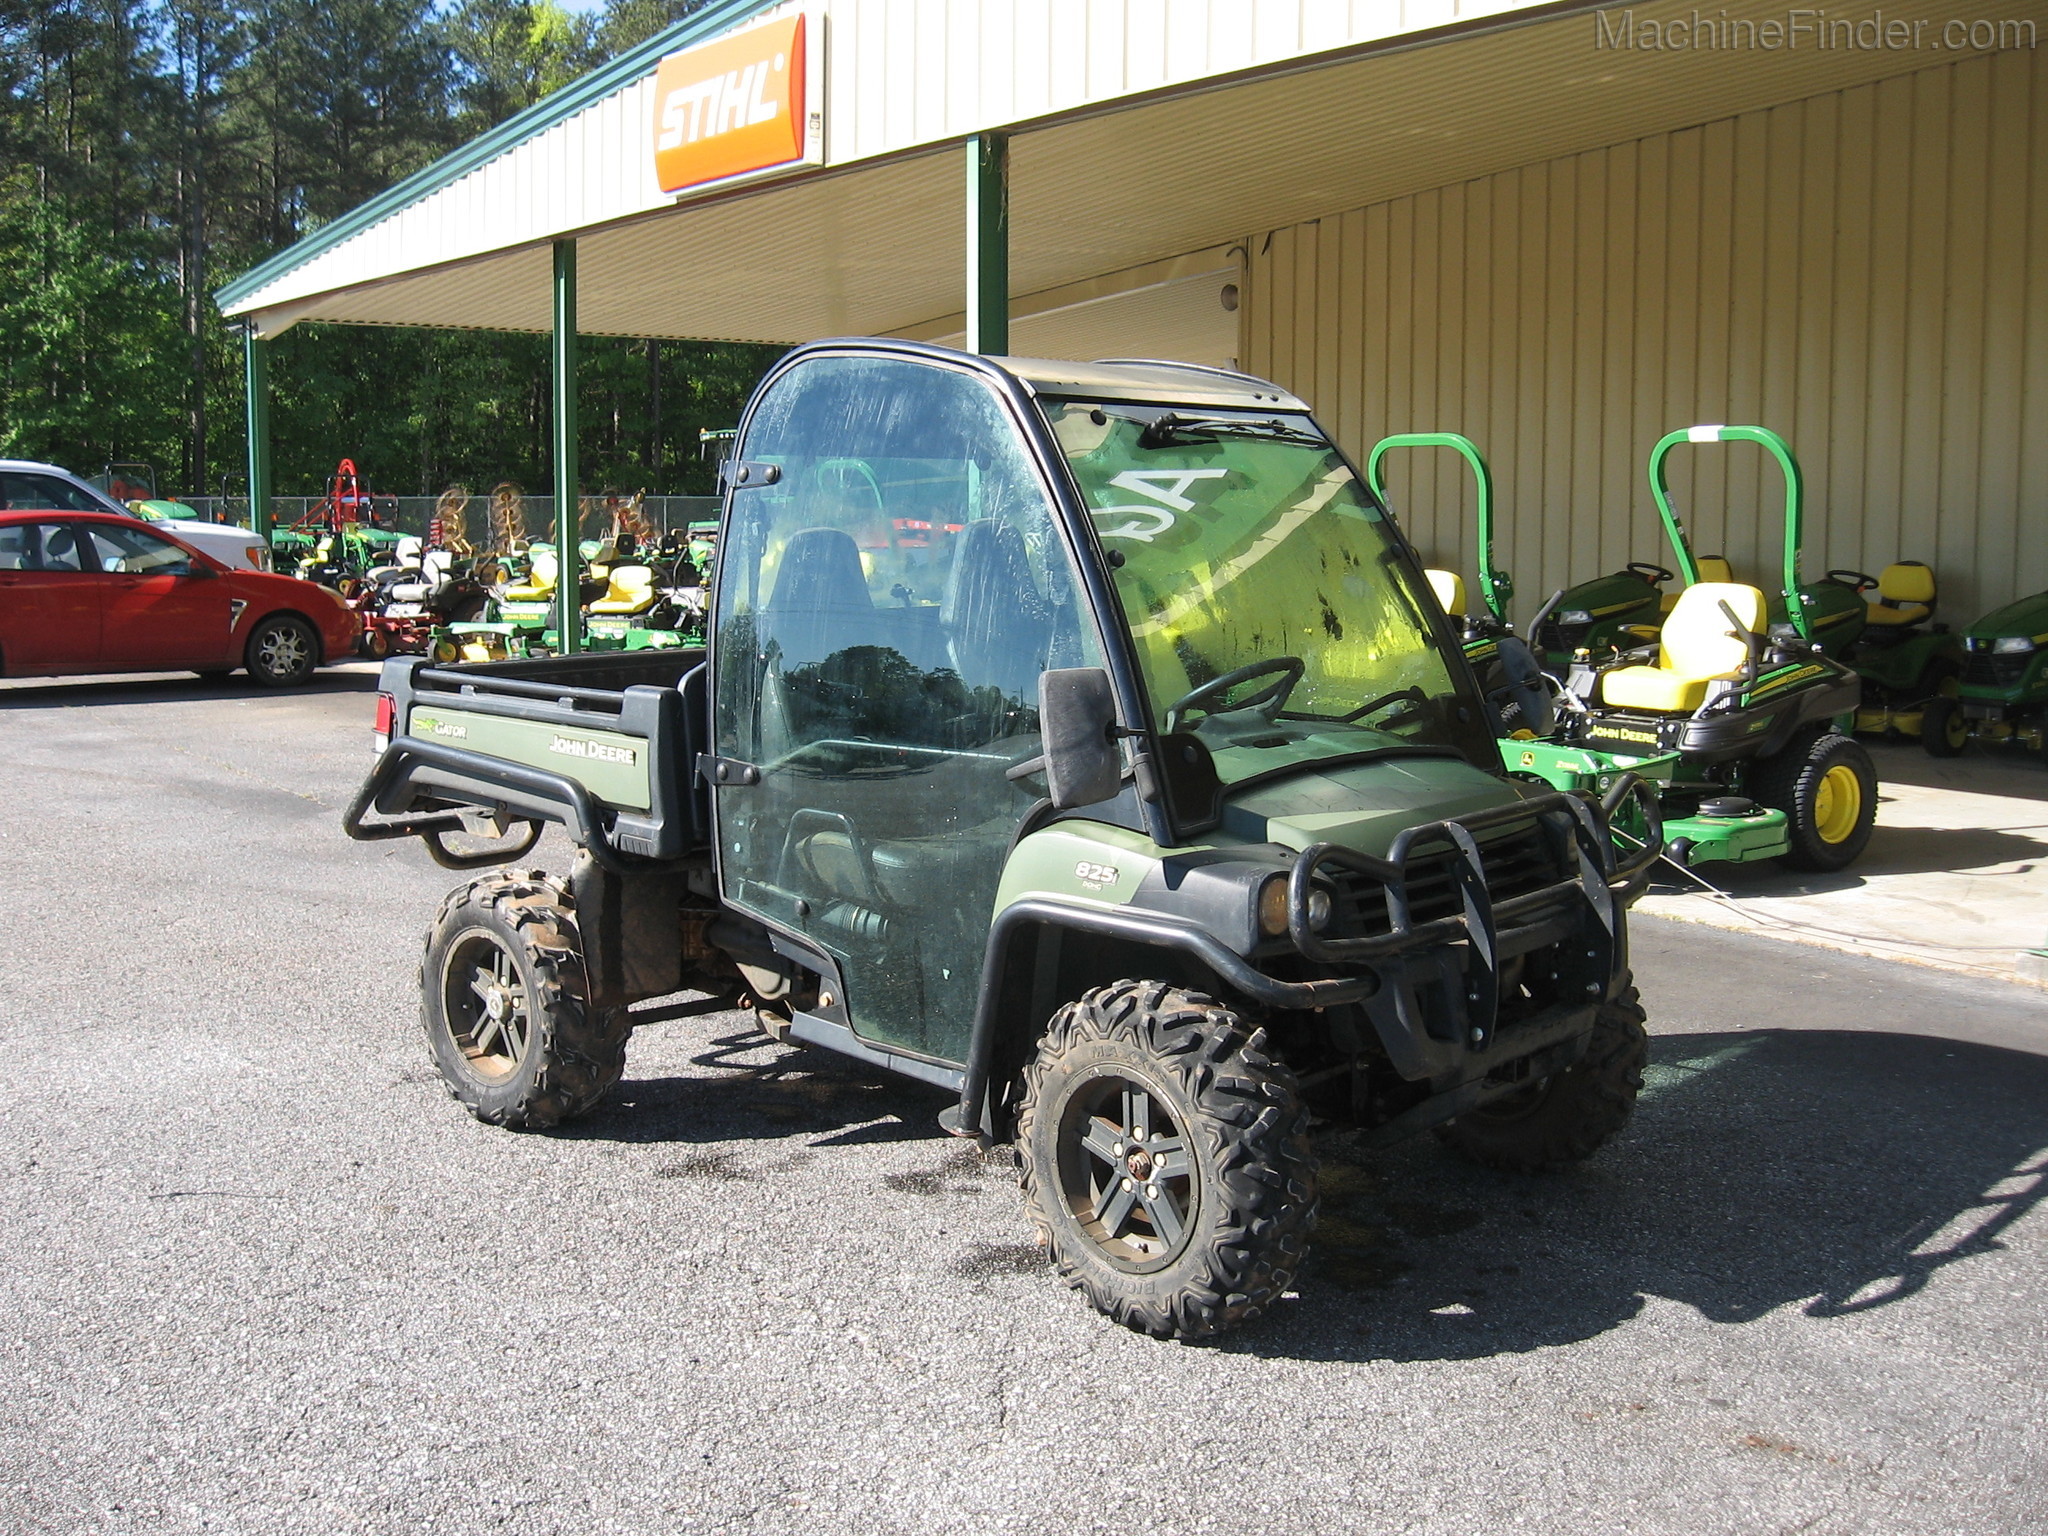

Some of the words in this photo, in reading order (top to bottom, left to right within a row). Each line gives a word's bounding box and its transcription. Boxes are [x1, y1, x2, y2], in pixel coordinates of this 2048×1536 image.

[657, 60, 778, 152] STIHL
[435, 721, 467, 739] GATOR
[1590, 724, 1619, 739] JOHN
[1620, 727, 1658, 744] DEERE
[549, 734, 586, 757] JOHN
[587, 740, 635, 766] DEERE
